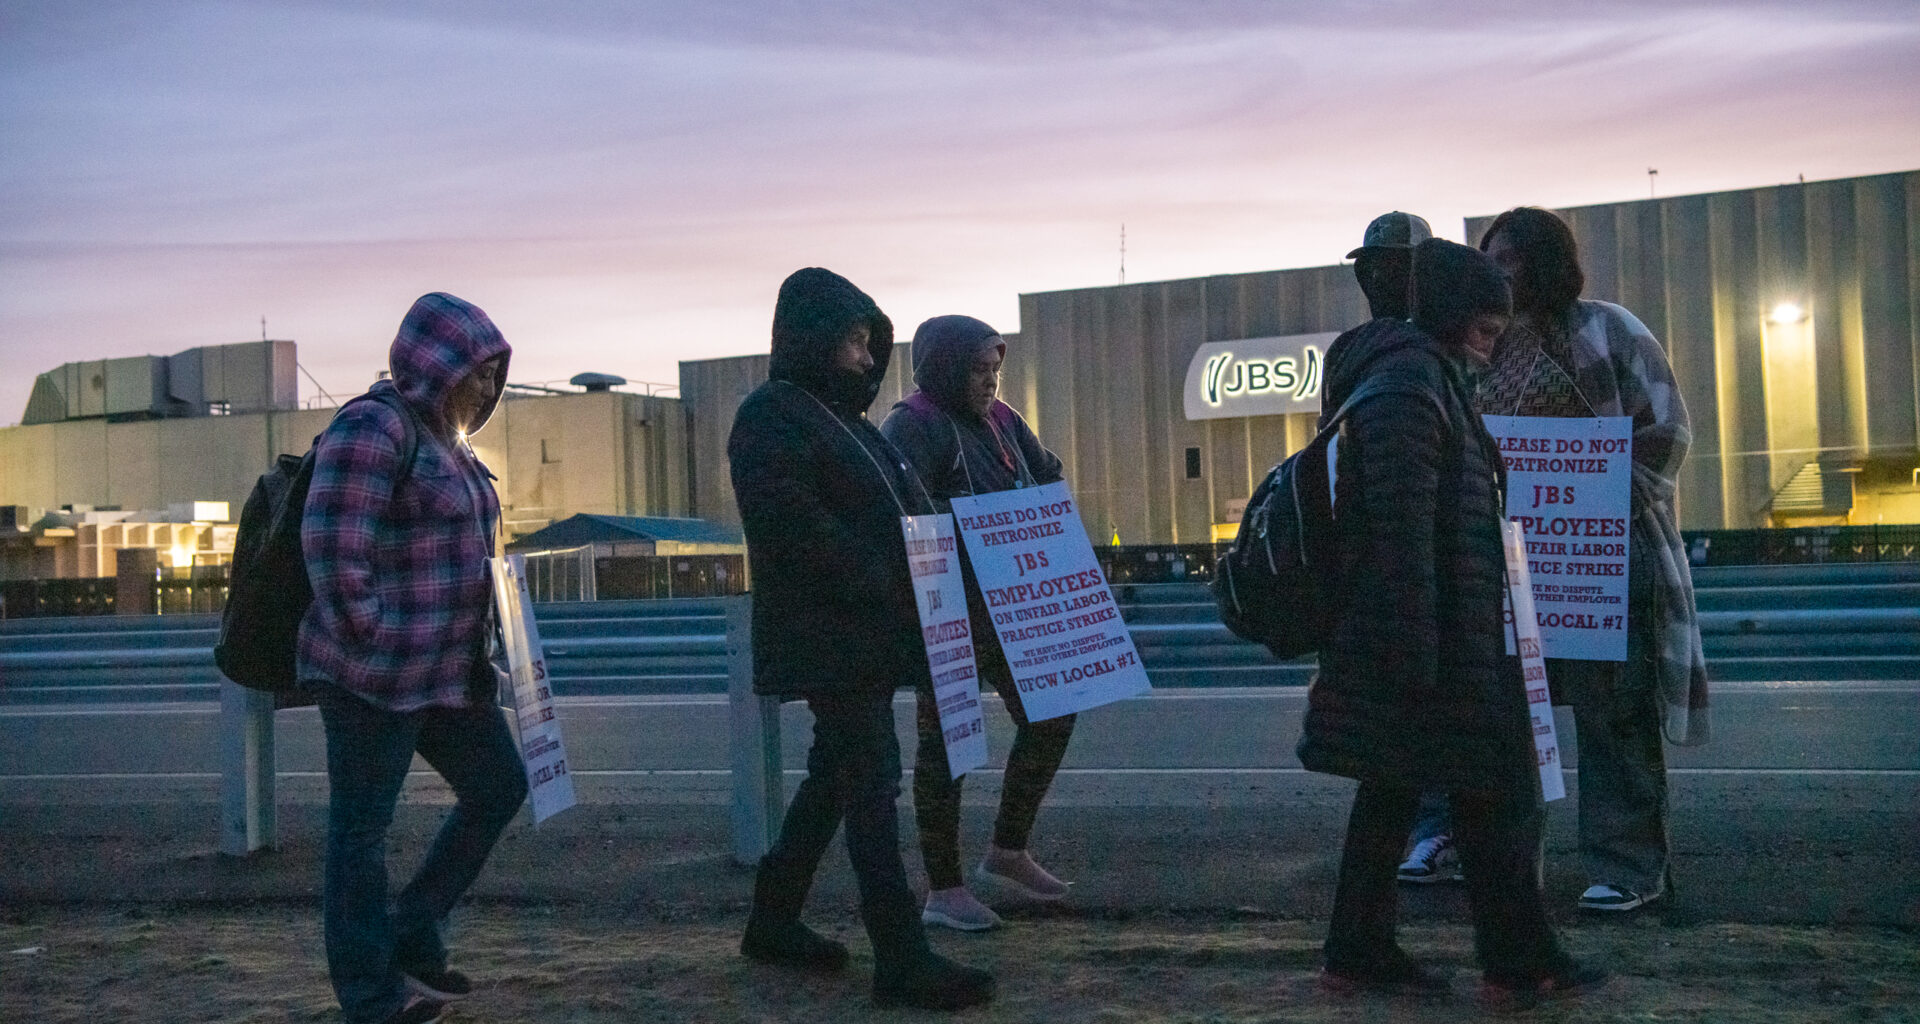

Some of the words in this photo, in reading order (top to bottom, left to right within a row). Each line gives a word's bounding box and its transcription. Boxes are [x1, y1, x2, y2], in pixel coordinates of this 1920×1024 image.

[1225, 361, 1296, 392] JBS
[1496, 436, 1550, 453] LEASE
[1555, 439, 1584, 454] DO
[1588, 438, 1628, 453] NOT
[1503, 457, 1608, 473] PATRONIZE
[1532, 485, 1575, 508] JBS
[961, 511, 1013, 530] PLEASE
[1014, 508, 1037, 523] DO
[1038, 500, 1072, 519] NOT
[981, 521, 1064, 547] PATRONIZE
[1571, 543, 1626, 557] LABOR
[1013, 550, 1049, 577] JBS
[1566, 562, 1624, 577] STRIKE
[986, 568, 1103, 607] EMPLOYEES
[1544, 584, 1560, 593] NO
[1562, 585, 1604, 595] DISPUTE
[1567, 595, 1621, 604] EMPLOYER
[994, 613, 1014, 625] ON
[1015, 603, 1062, 622] UNFAIR
[1063, 590, 1111, 612] LABOR
[1001, 620, 1066, 644] PRACTICE
[1066, 606, 1117, 631] STRIKE
[1536, 612, 1598, 630] LOCAL
[1602, 615, 1623, 630] #7
[1012, 659, 1033, 669] WITH
[1034, 656, 1050, 666] ANY
[1051, 650, 1079, 662] OTHER
[1079, 635, 1126, 655] EMPLOYER
[1022, 650, 1036, 658] WE
[1037, 646, 1057, 656] HAVE
[1058, 641, 1071, 650] NO
[1072, 632, 1106, 647] DISPUTE
[1017, 672, 1058, 693] UFCW
[1060, 659, 1116, 684] LOCAL
[1116, 651, 1137, 669] #7
